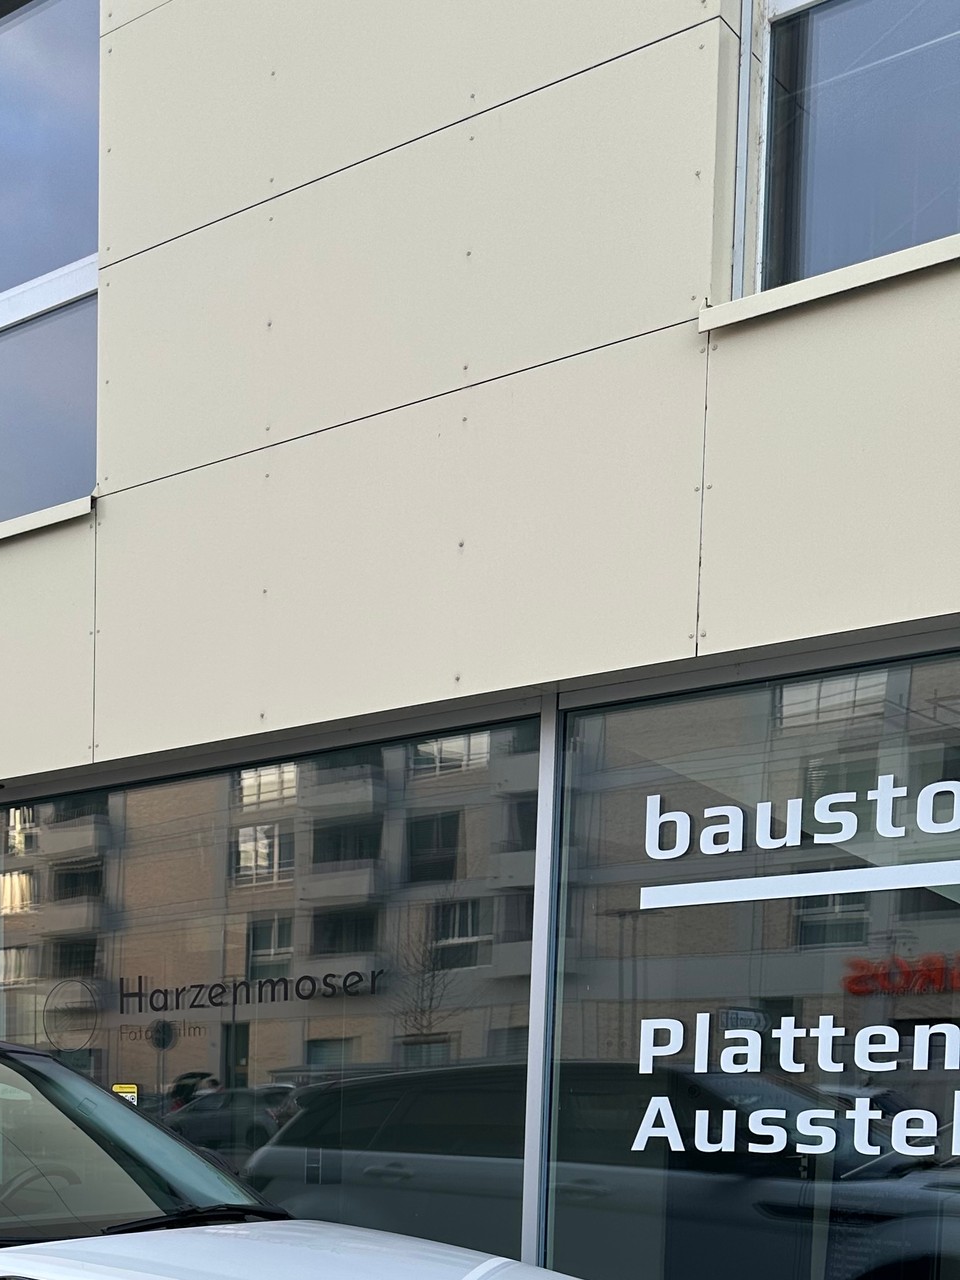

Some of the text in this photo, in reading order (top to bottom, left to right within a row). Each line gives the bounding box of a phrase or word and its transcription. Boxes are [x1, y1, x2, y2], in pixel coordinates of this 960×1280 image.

[645, 774, 960, 860] bausto
[119, 968, 385, 1015] Harzenmoser
[120, 1024, 152, 1041] Foto
[639, 1012, 960, 1075] Platten
